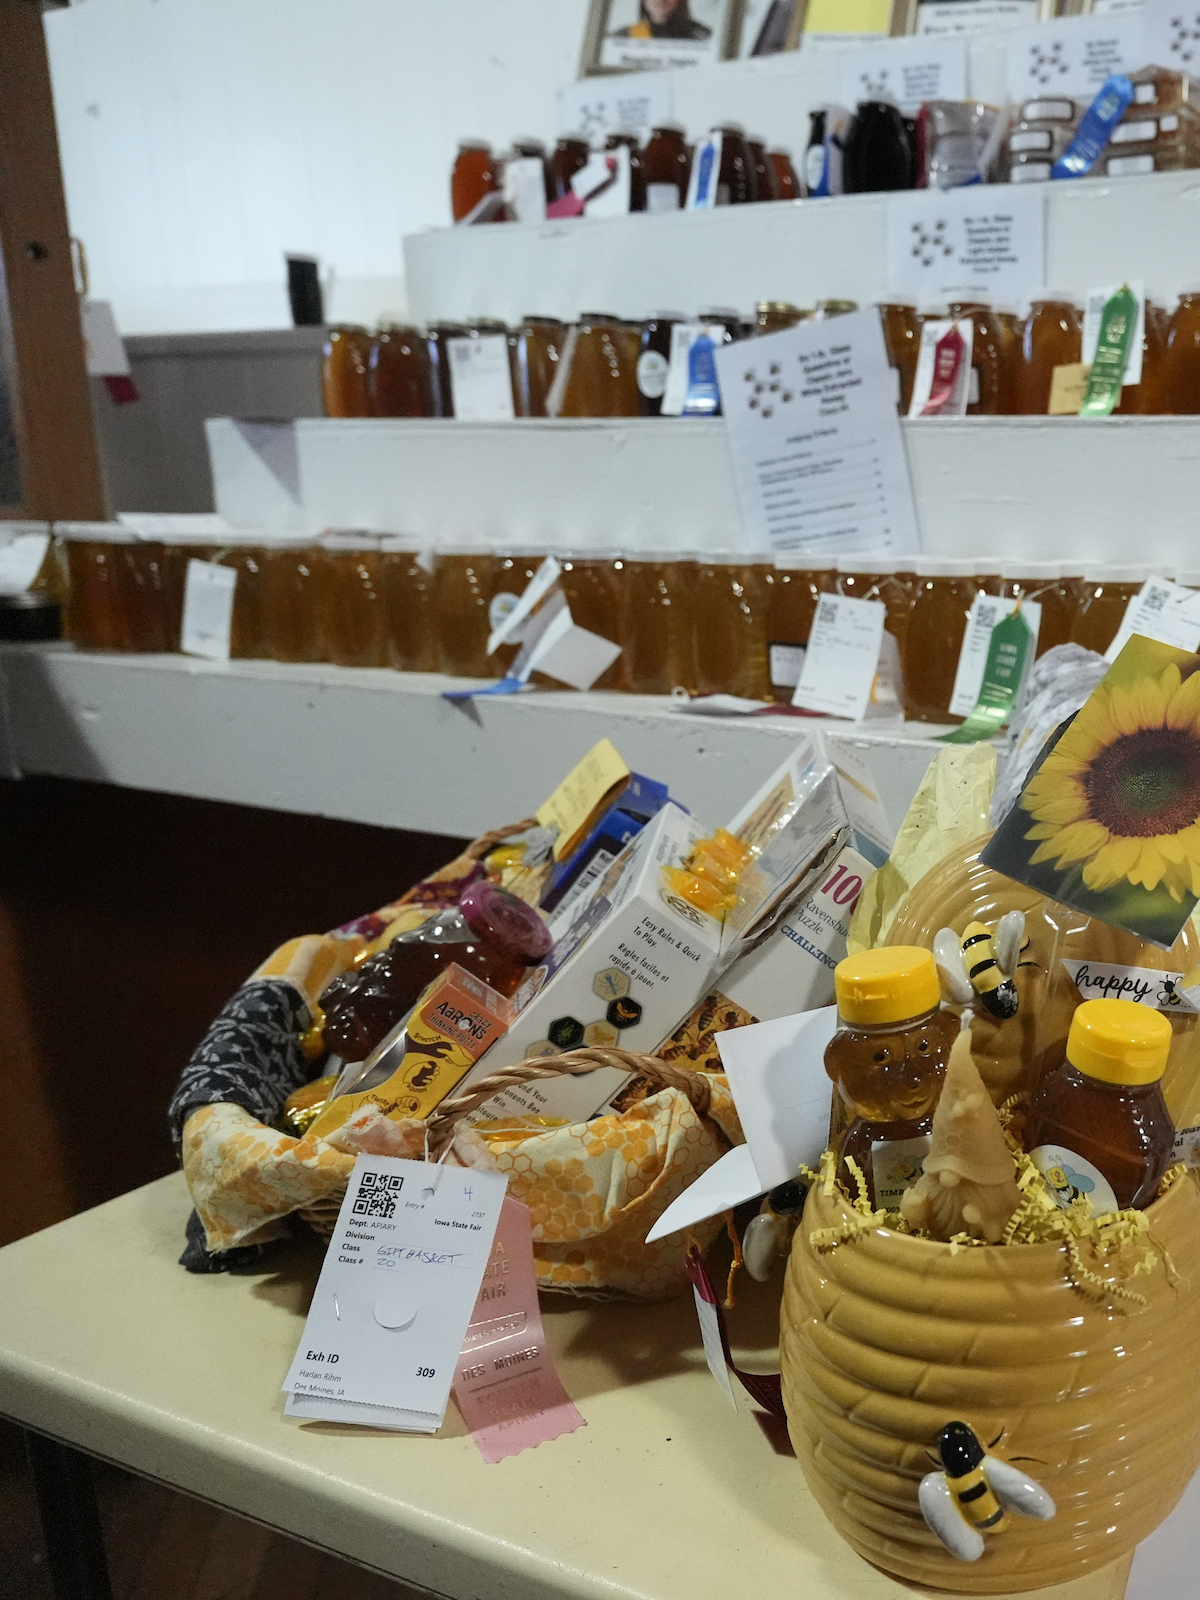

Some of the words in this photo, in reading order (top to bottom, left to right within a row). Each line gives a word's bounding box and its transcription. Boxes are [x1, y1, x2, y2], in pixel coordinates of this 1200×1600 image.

[633, 926, 642, 936] To
[641, 916, 658, 932] Easy
[657, 928, 675, 945] Rules
[675, 941, 682, 949] &
[682, 945, 701, 963] Quick
[609, 954, 630, 971] rapide
[640, 957, 662, 977] faciles
[661, 975, 670, 983] et
[1075, 964, 1154, 1003] happy
[493, 1095, 506, 1109] Win
[532, 1088, 548, 1104] Your
[527, 1102, 541, 1115] Bee
[464, 1186, 473, 1201] 4
[405, 1201, 420, 1211] Entry
[349, 1218, 368, 1228] Dept.
[371, 1221, 398, 1231] APIARY
[434, 1218, 450, 1227] Iowa
[451, 1220, 468, 1230] State
[469, 1223, 482, 1231] Fair
[345, 1230, 375, 1241] Division
[342, 1243, 361, 1252] Class
[338, 1255, 358, 1264] Class
[405, 1250, 463, 1265] BASKET
[481, 1282, 507, 1301] AIR
[306, 1350, 325, 1362] Exh
[326, 1354, 340, 1364] ID
[462, 1363, 486, 1382] DES
[493, 1345, 540, 1370] MOINES
[299, 1369, 322, 1380] Harlan
[323, 1372, 342, 1383] Rihm
[415, 1366, 436, 1378] 309
[294, 1382, 308, 1391] Des
[336, 1388, 345, 1396] IA
